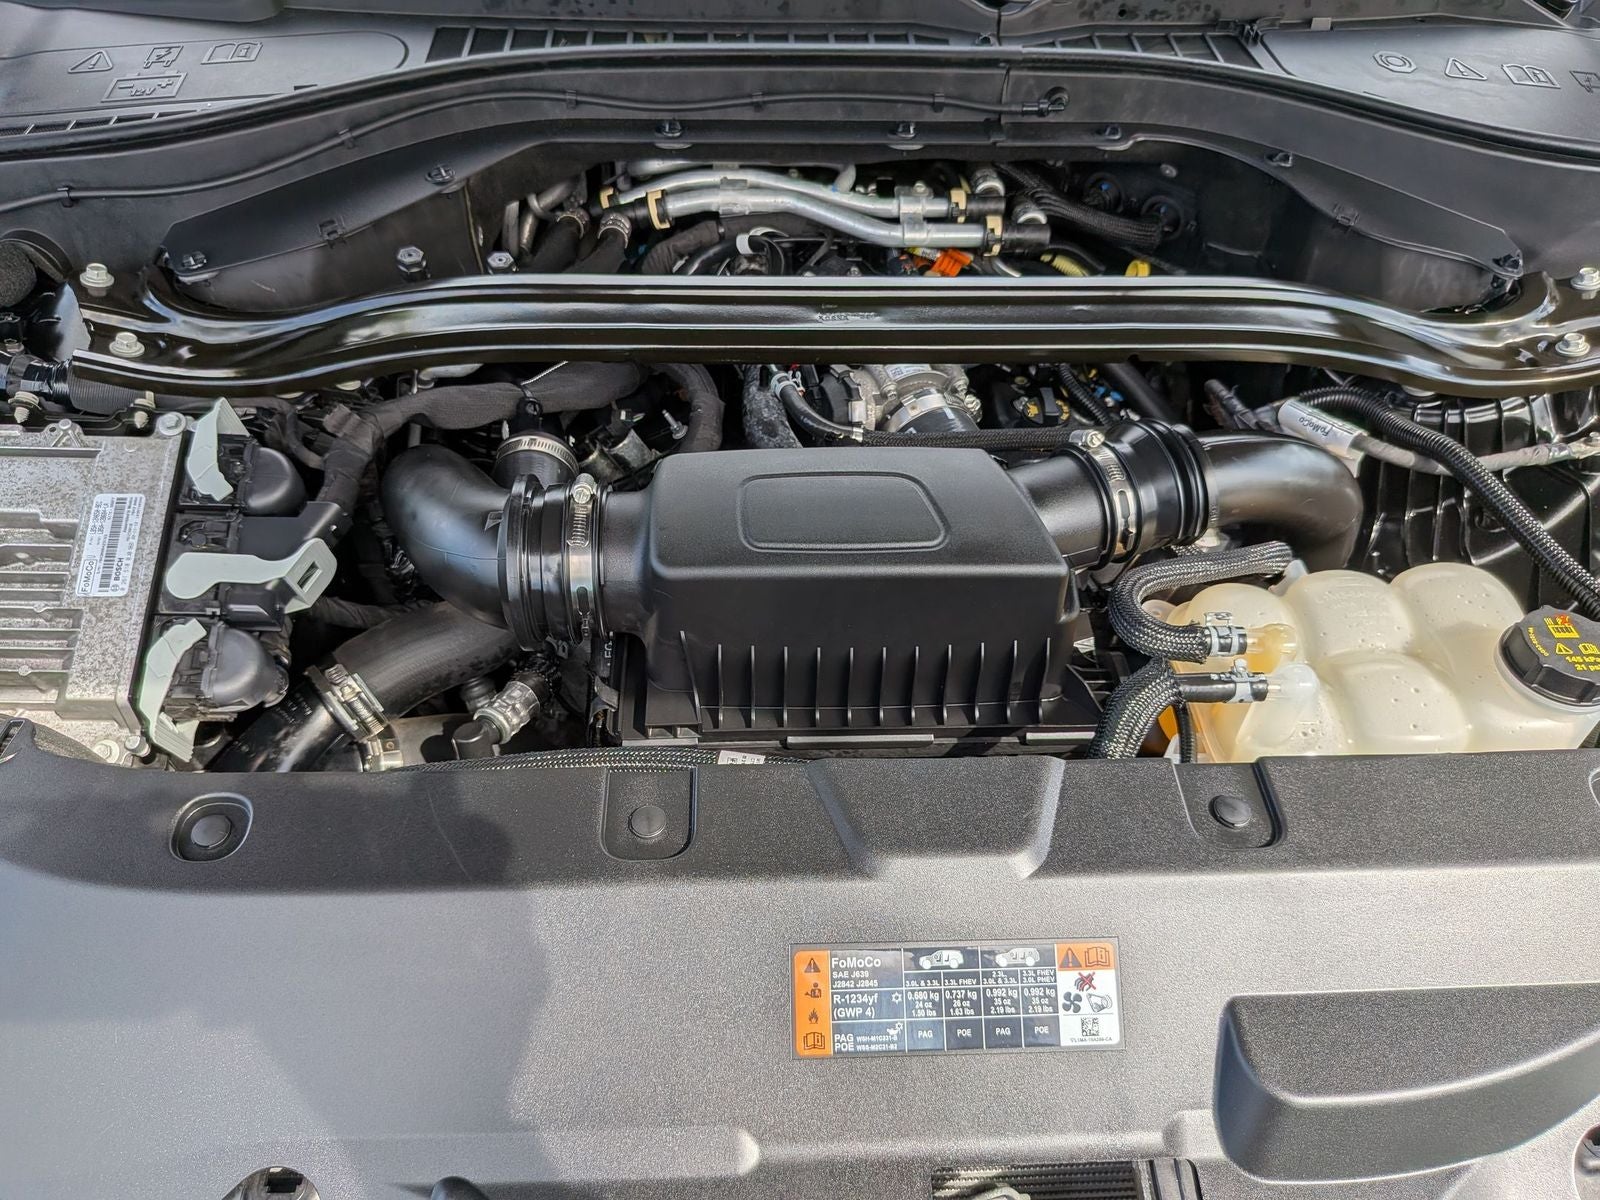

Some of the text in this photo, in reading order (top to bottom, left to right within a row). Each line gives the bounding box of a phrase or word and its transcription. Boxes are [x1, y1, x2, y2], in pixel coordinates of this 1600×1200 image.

[1299, 417, 1331, 436] FoMoCo
[114, 558, 124, 581] BOSCH
[81, 560, 95, 593] FoMoCo
[832, 956, 882, 968] FoMoCo
[833, 979, 878, 988] J2842 J2845
[907, 991, 939, 1001] 0.680 kg
[945, 990, 977, 1000] 0.737 kg
[986, 988, 1018, 998] 0.992 kg
[1024, 987, 1056, 997] 0.992 kg
[833, 993, 879, 1005] R-1234yf
[833, 1007, 875, 1020] (GWP 4)
[912, 1009, 925, 1017] 1.50
[950, 1008, 963, 1016] 1.63
[1028, 1005, 1042, 1013] 2.19
[918, 1030, 933, 1038] PAG
[957, 1029, 972, 1037] POE
[996, 1027, 1011, 1035] PAG
[1034, 1026, 1049, 1034] POE
[834, 1033, 854, 1043] PAG
[834, 1042, 854, 1052] POE
